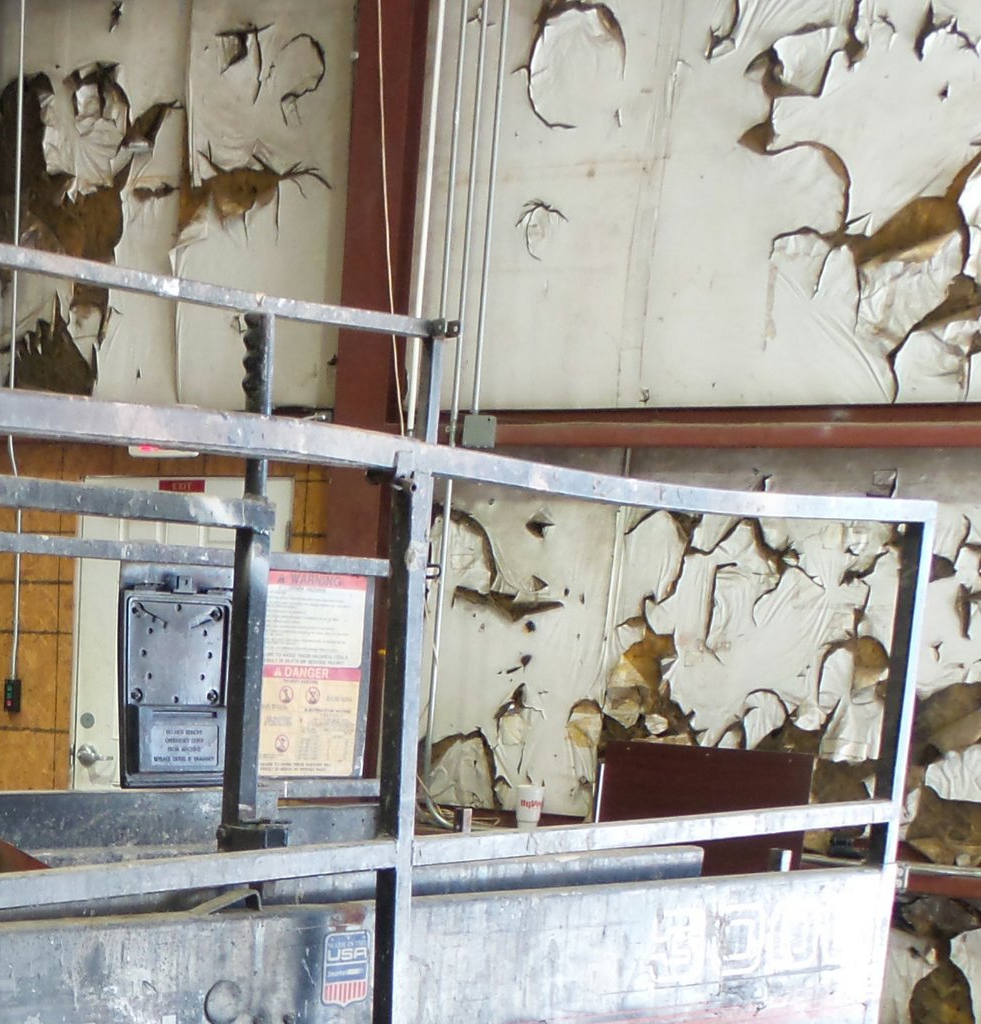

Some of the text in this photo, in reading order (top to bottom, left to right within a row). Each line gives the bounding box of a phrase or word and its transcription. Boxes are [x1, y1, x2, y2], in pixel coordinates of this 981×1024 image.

[290, 573, 342, 587] WARNING
[284, 667, 329, 679] DANGER
[327, 947, 367, 961] USA
